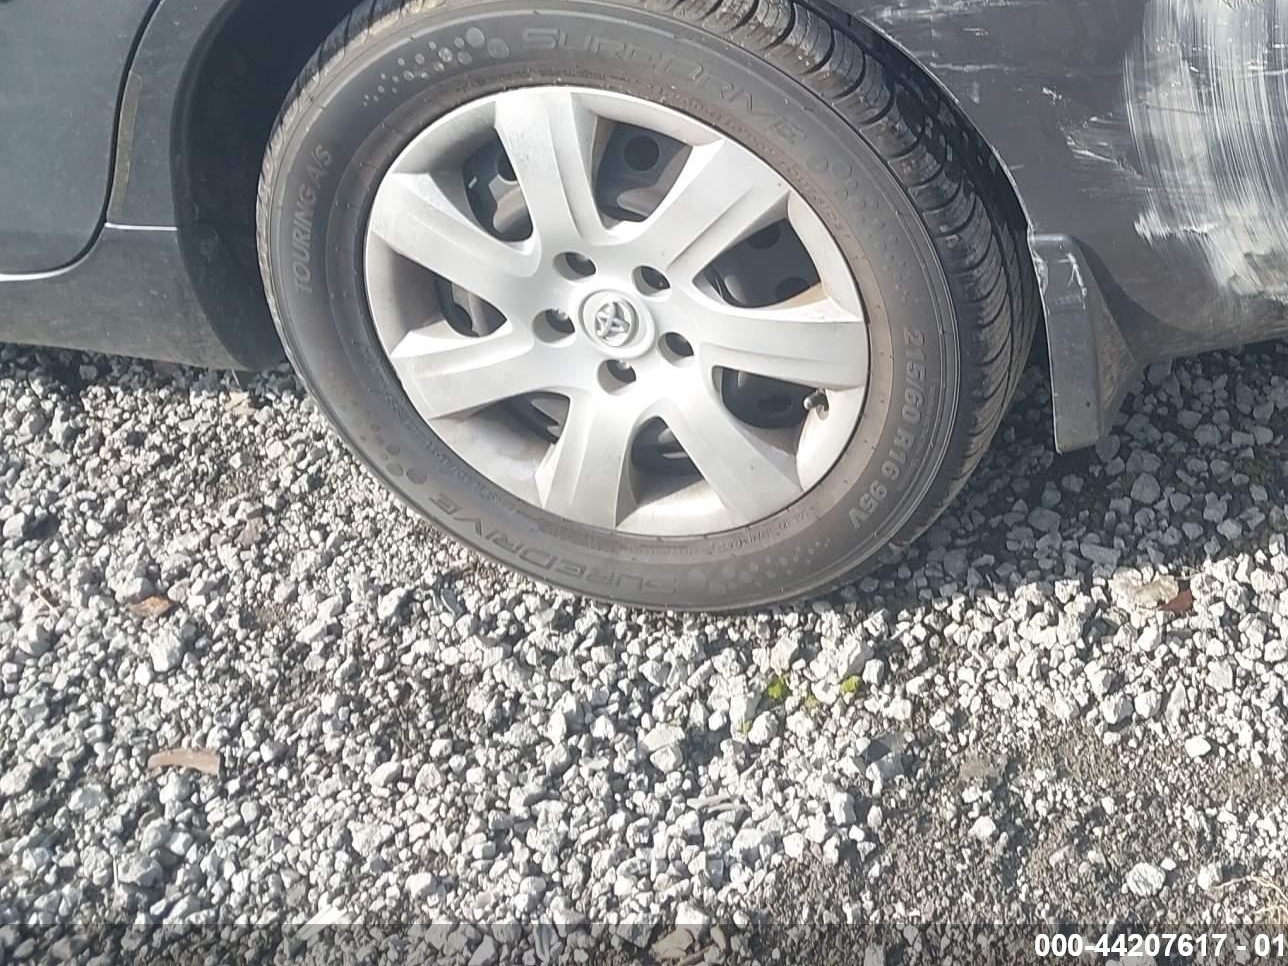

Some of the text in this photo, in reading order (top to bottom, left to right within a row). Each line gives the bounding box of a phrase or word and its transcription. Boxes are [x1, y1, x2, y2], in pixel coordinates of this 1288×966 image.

[292, 144, 332, 293] TOURING A/S
[902, 328, 927, 422] 215/60
[881, 428, 915, 480] R16
[848, 480, 888, 530] 95V
